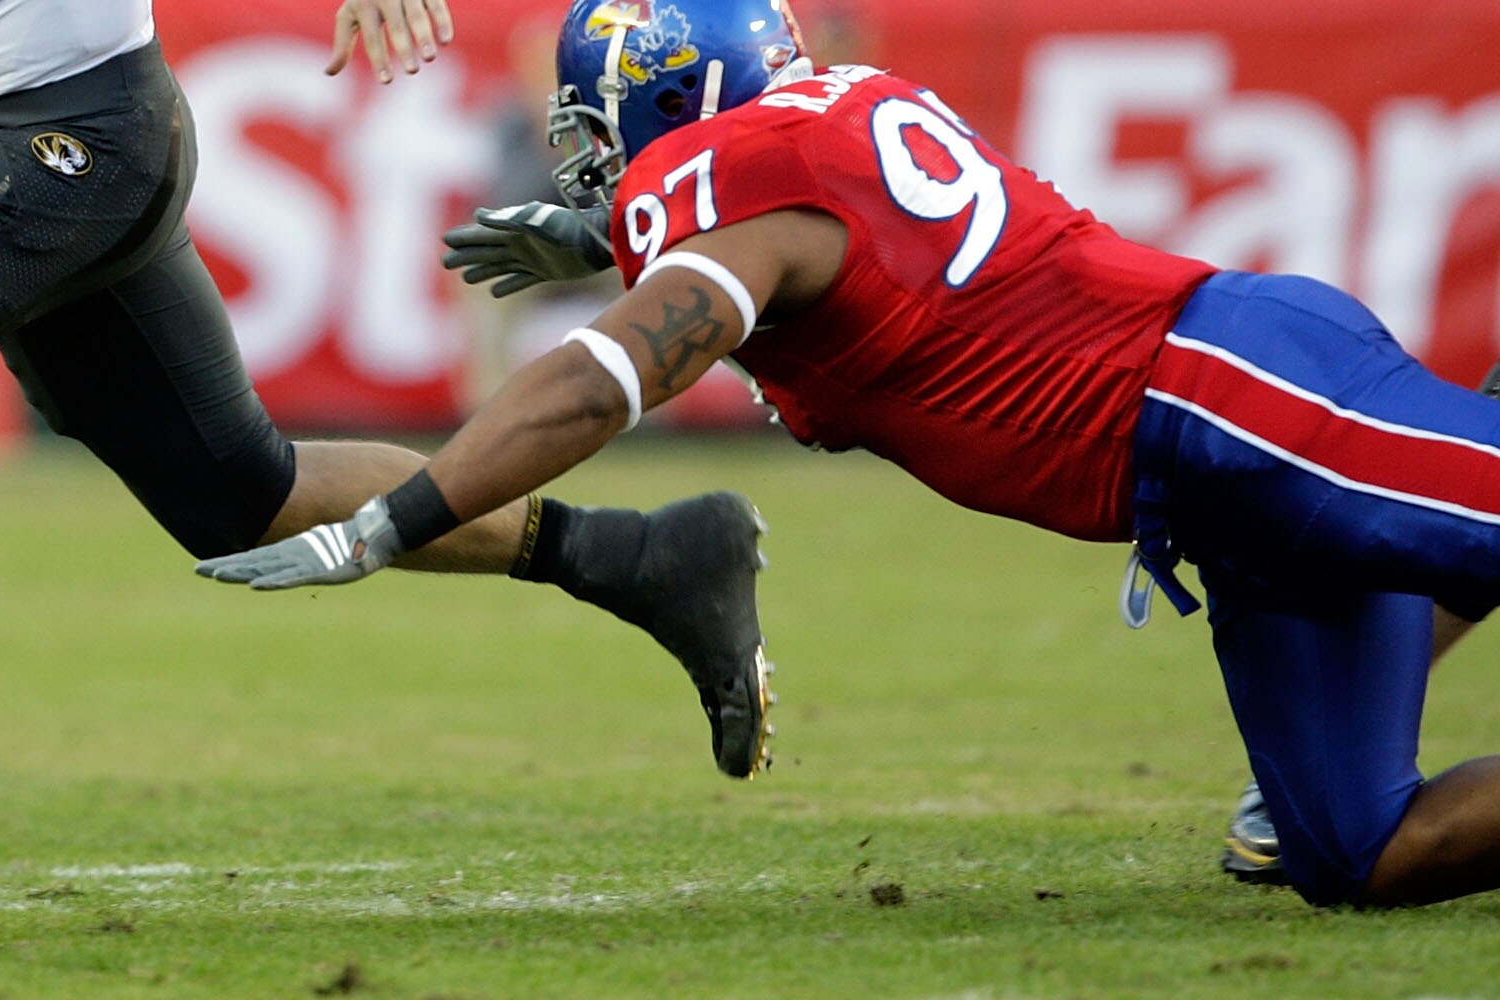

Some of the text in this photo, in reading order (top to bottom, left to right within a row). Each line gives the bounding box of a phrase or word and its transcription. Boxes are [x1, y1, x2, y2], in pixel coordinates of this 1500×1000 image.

[637, 31, 664, 53] KU
[623, 147, 720, 266] 97
[1012, 32, 1500, 362] Far
